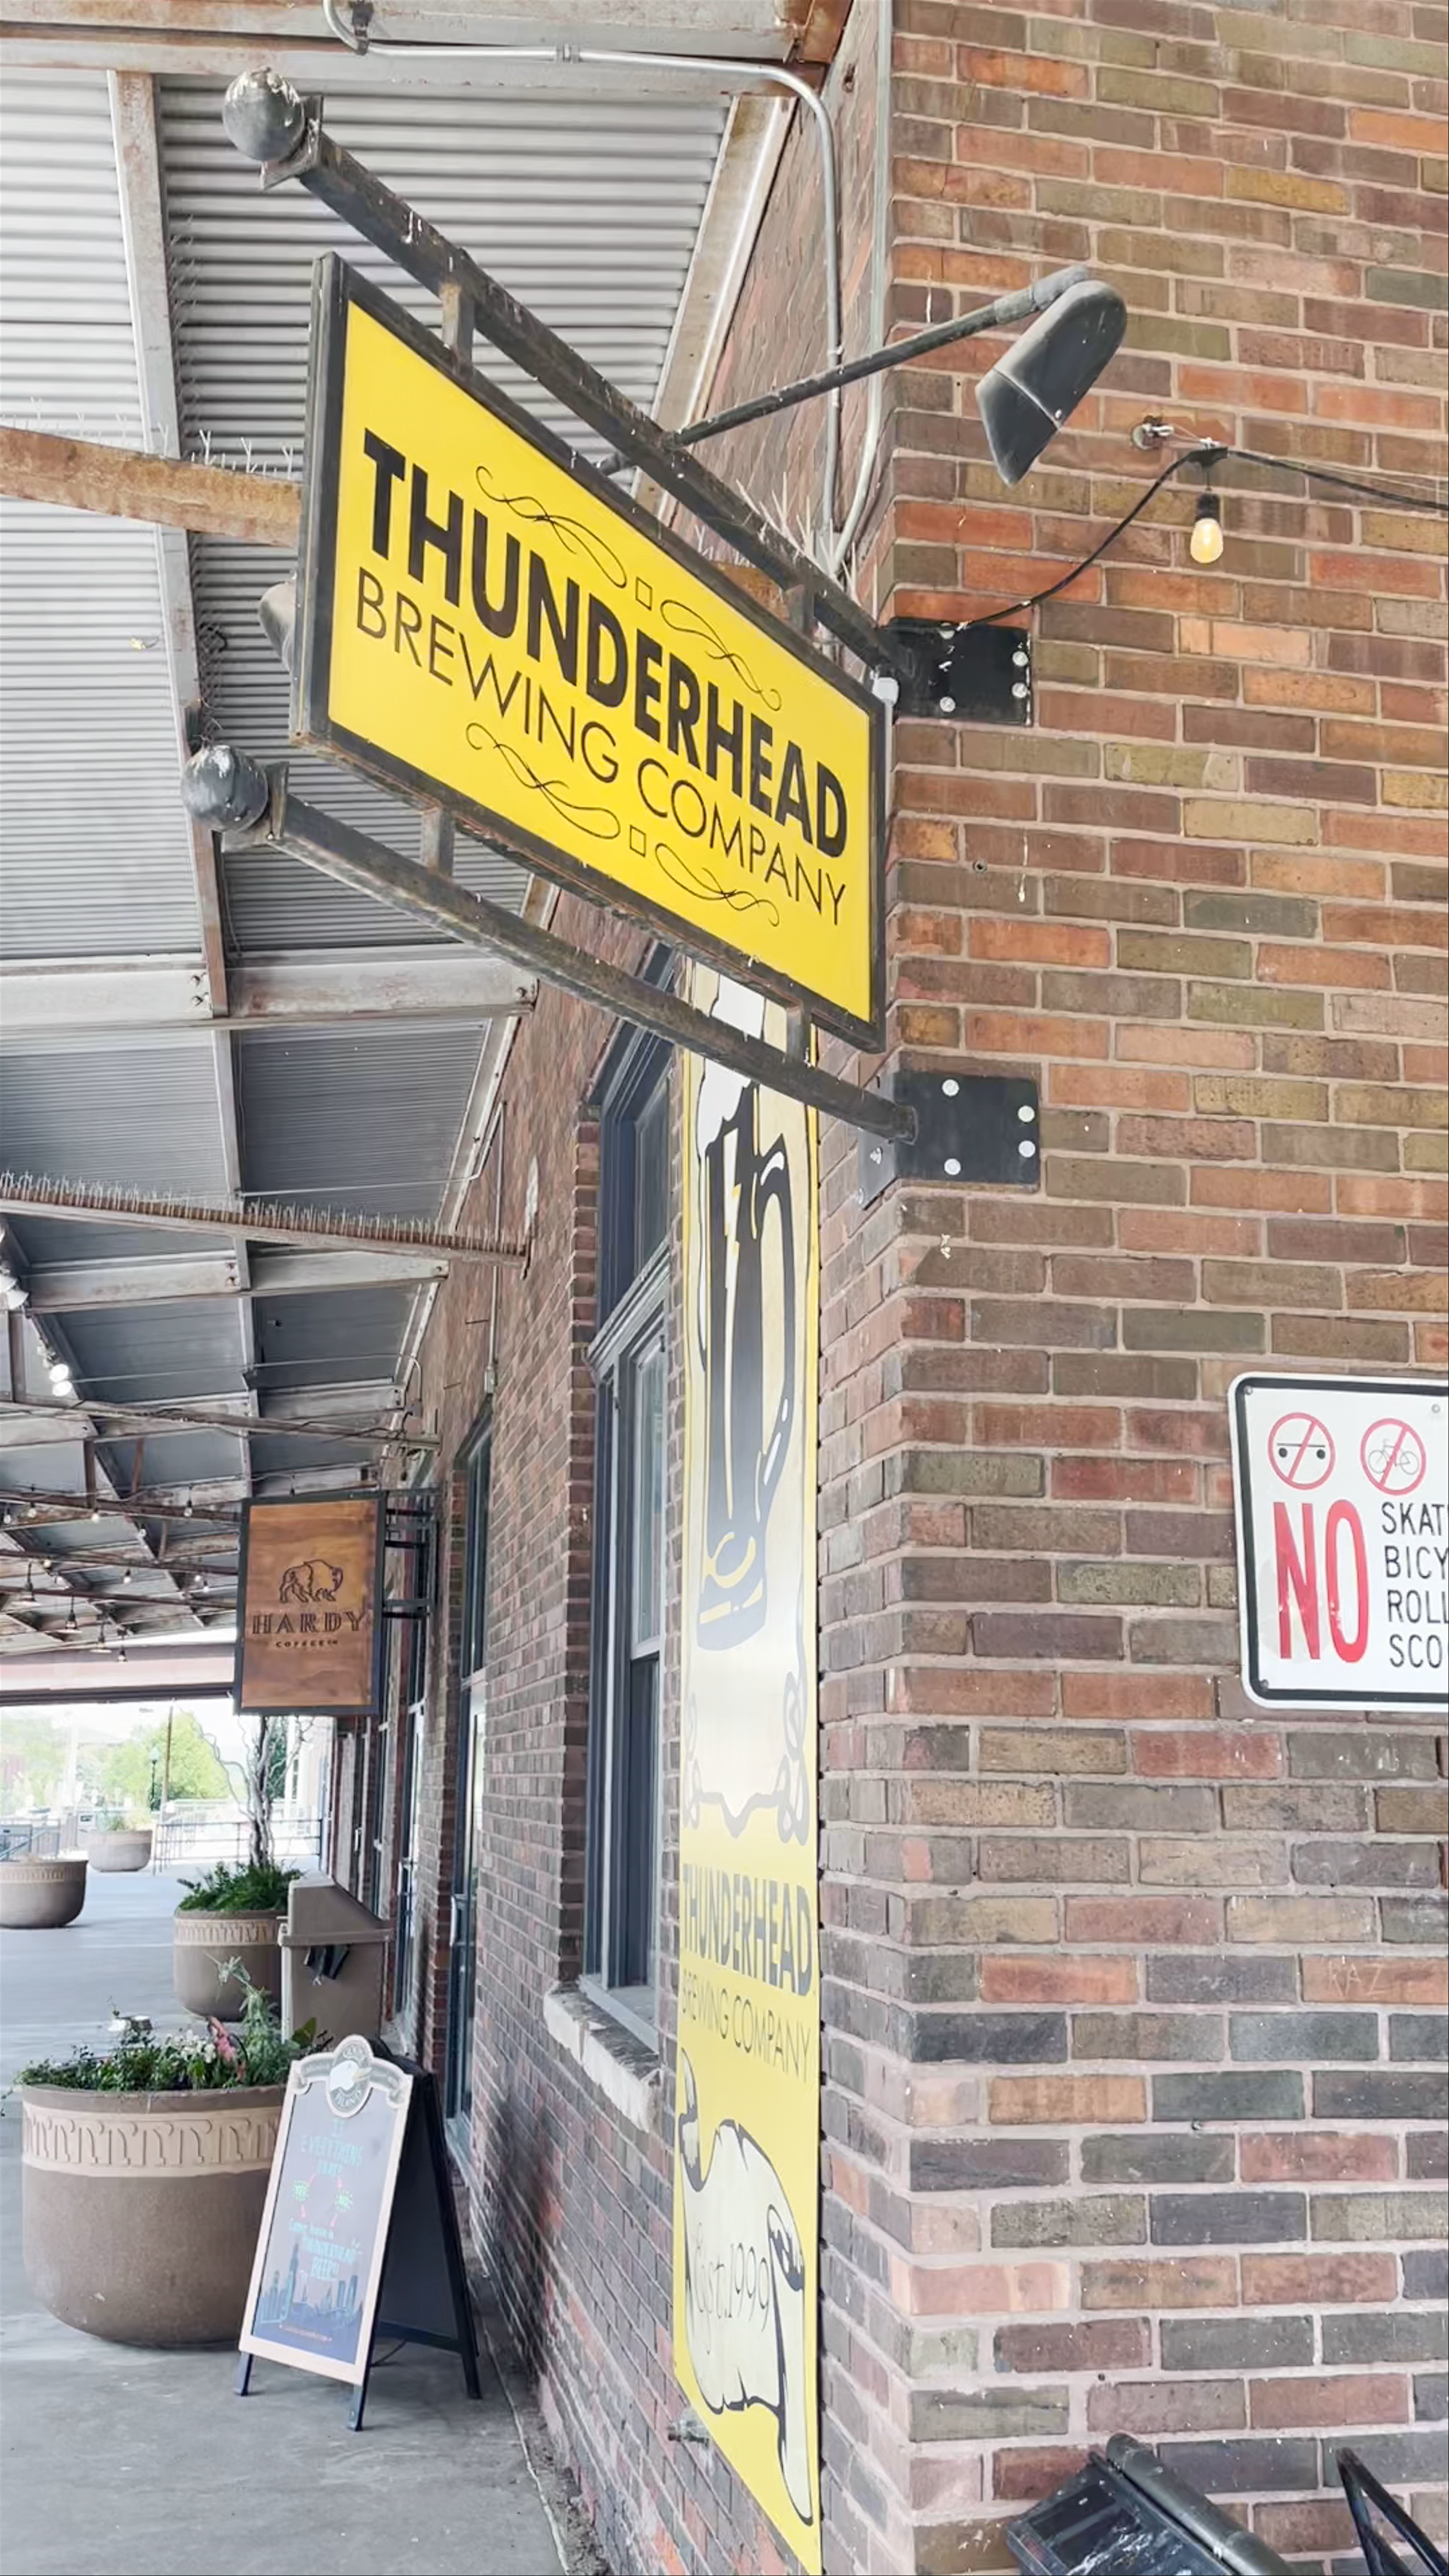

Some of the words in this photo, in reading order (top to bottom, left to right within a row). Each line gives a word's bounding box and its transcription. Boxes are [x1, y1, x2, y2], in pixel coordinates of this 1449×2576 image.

[364, 428, 847, 858] THUNDERHEAD
[357, 567, 618, 783] BREWING
[638, 758, 845, 925] COMPANY
[1382, 1501, 1449, 1536] SKAT
[252, 1611, 365, 1634] HARDY
[1273, 1499, 1369, 1663] NO
[1389, 1634, 1448, 1668] SCO
[683, 1863, 812, 1996] THUNDERHEAD
[682, 1967, 729, 2039] BREWING
[733, 1995, 811, 2083] COMPANY
